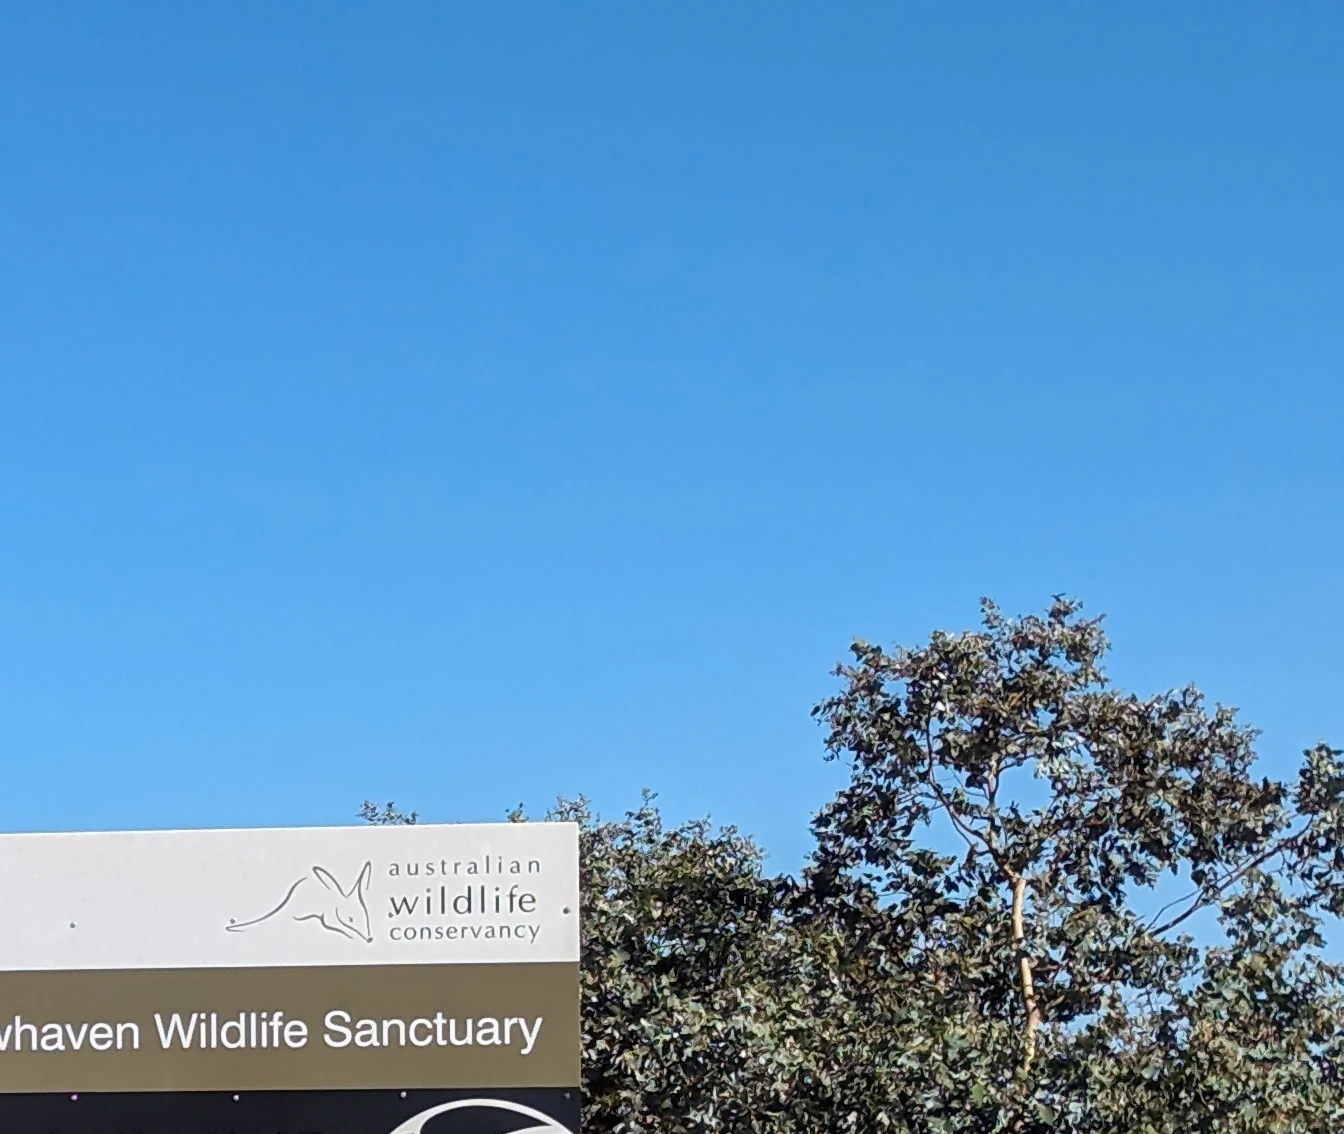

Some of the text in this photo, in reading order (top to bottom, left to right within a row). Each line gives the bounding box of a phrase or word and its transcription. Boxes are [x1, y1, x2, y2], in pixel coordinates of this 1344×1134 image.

[388, 855, 540, 877] australian
[389, 884, 537, 918] wildlife
[389, 924, 541, 944] conservancy
[153, 1011, 309, 1049] Wildlife
[323, 1010, 543, 1055] Sanctuary
